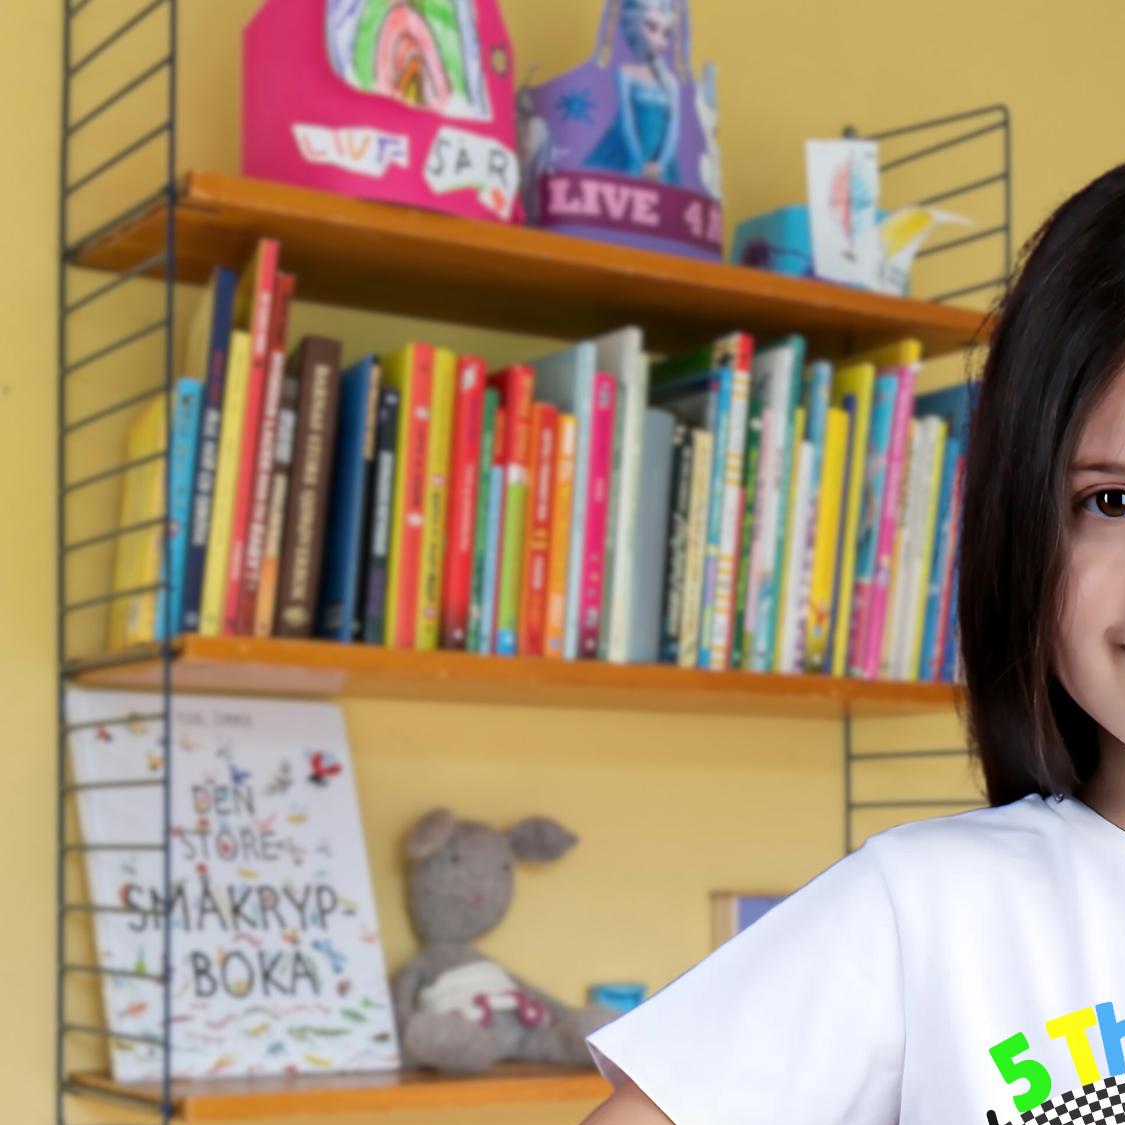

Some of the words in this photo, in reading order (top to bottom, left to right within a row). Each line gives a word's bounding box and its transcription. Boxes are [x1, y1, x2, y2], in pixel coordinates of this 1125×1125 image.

[547, 177, 660, 227] LIVE
[191, 785, 256, 816] DEN
[191, 949, 320, 998] BOKA
[988, 1031, 1053, 1115] 5
